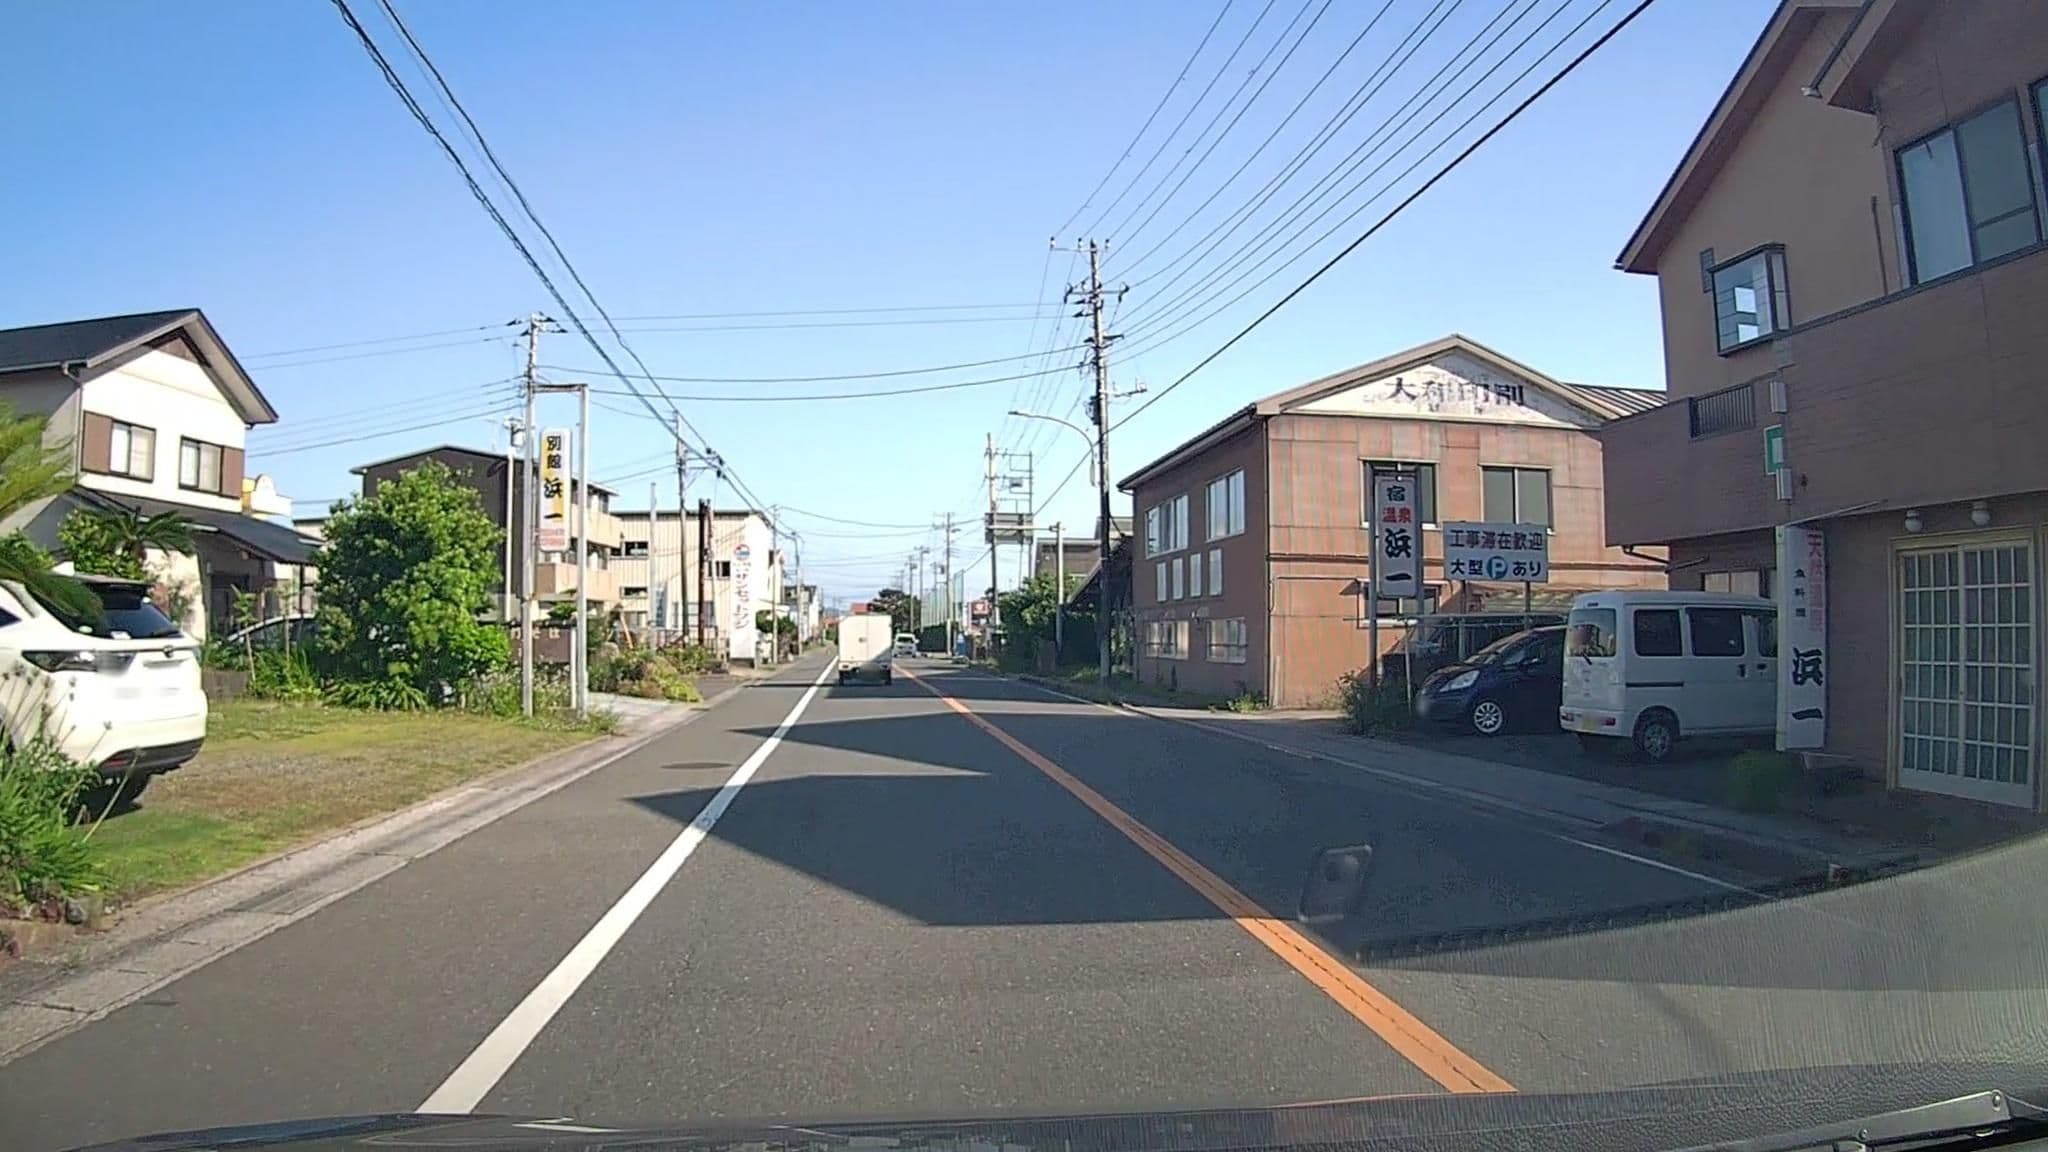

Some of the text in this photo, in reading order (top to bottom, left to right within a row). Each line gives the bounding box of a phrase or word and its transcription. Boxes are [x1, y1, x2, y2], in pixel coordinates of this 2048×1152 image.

[544, 478, 563, 519] 浜一
[1386, 485, 1406, 502] 宿
[1383, 507, 1412, 523] 温泉
[1385, 528, 1412, 582] 浜一
[1450, 529, 1544, 551] 工事滞在歓迎
[1791, 647, 1823, 720] 浜一
